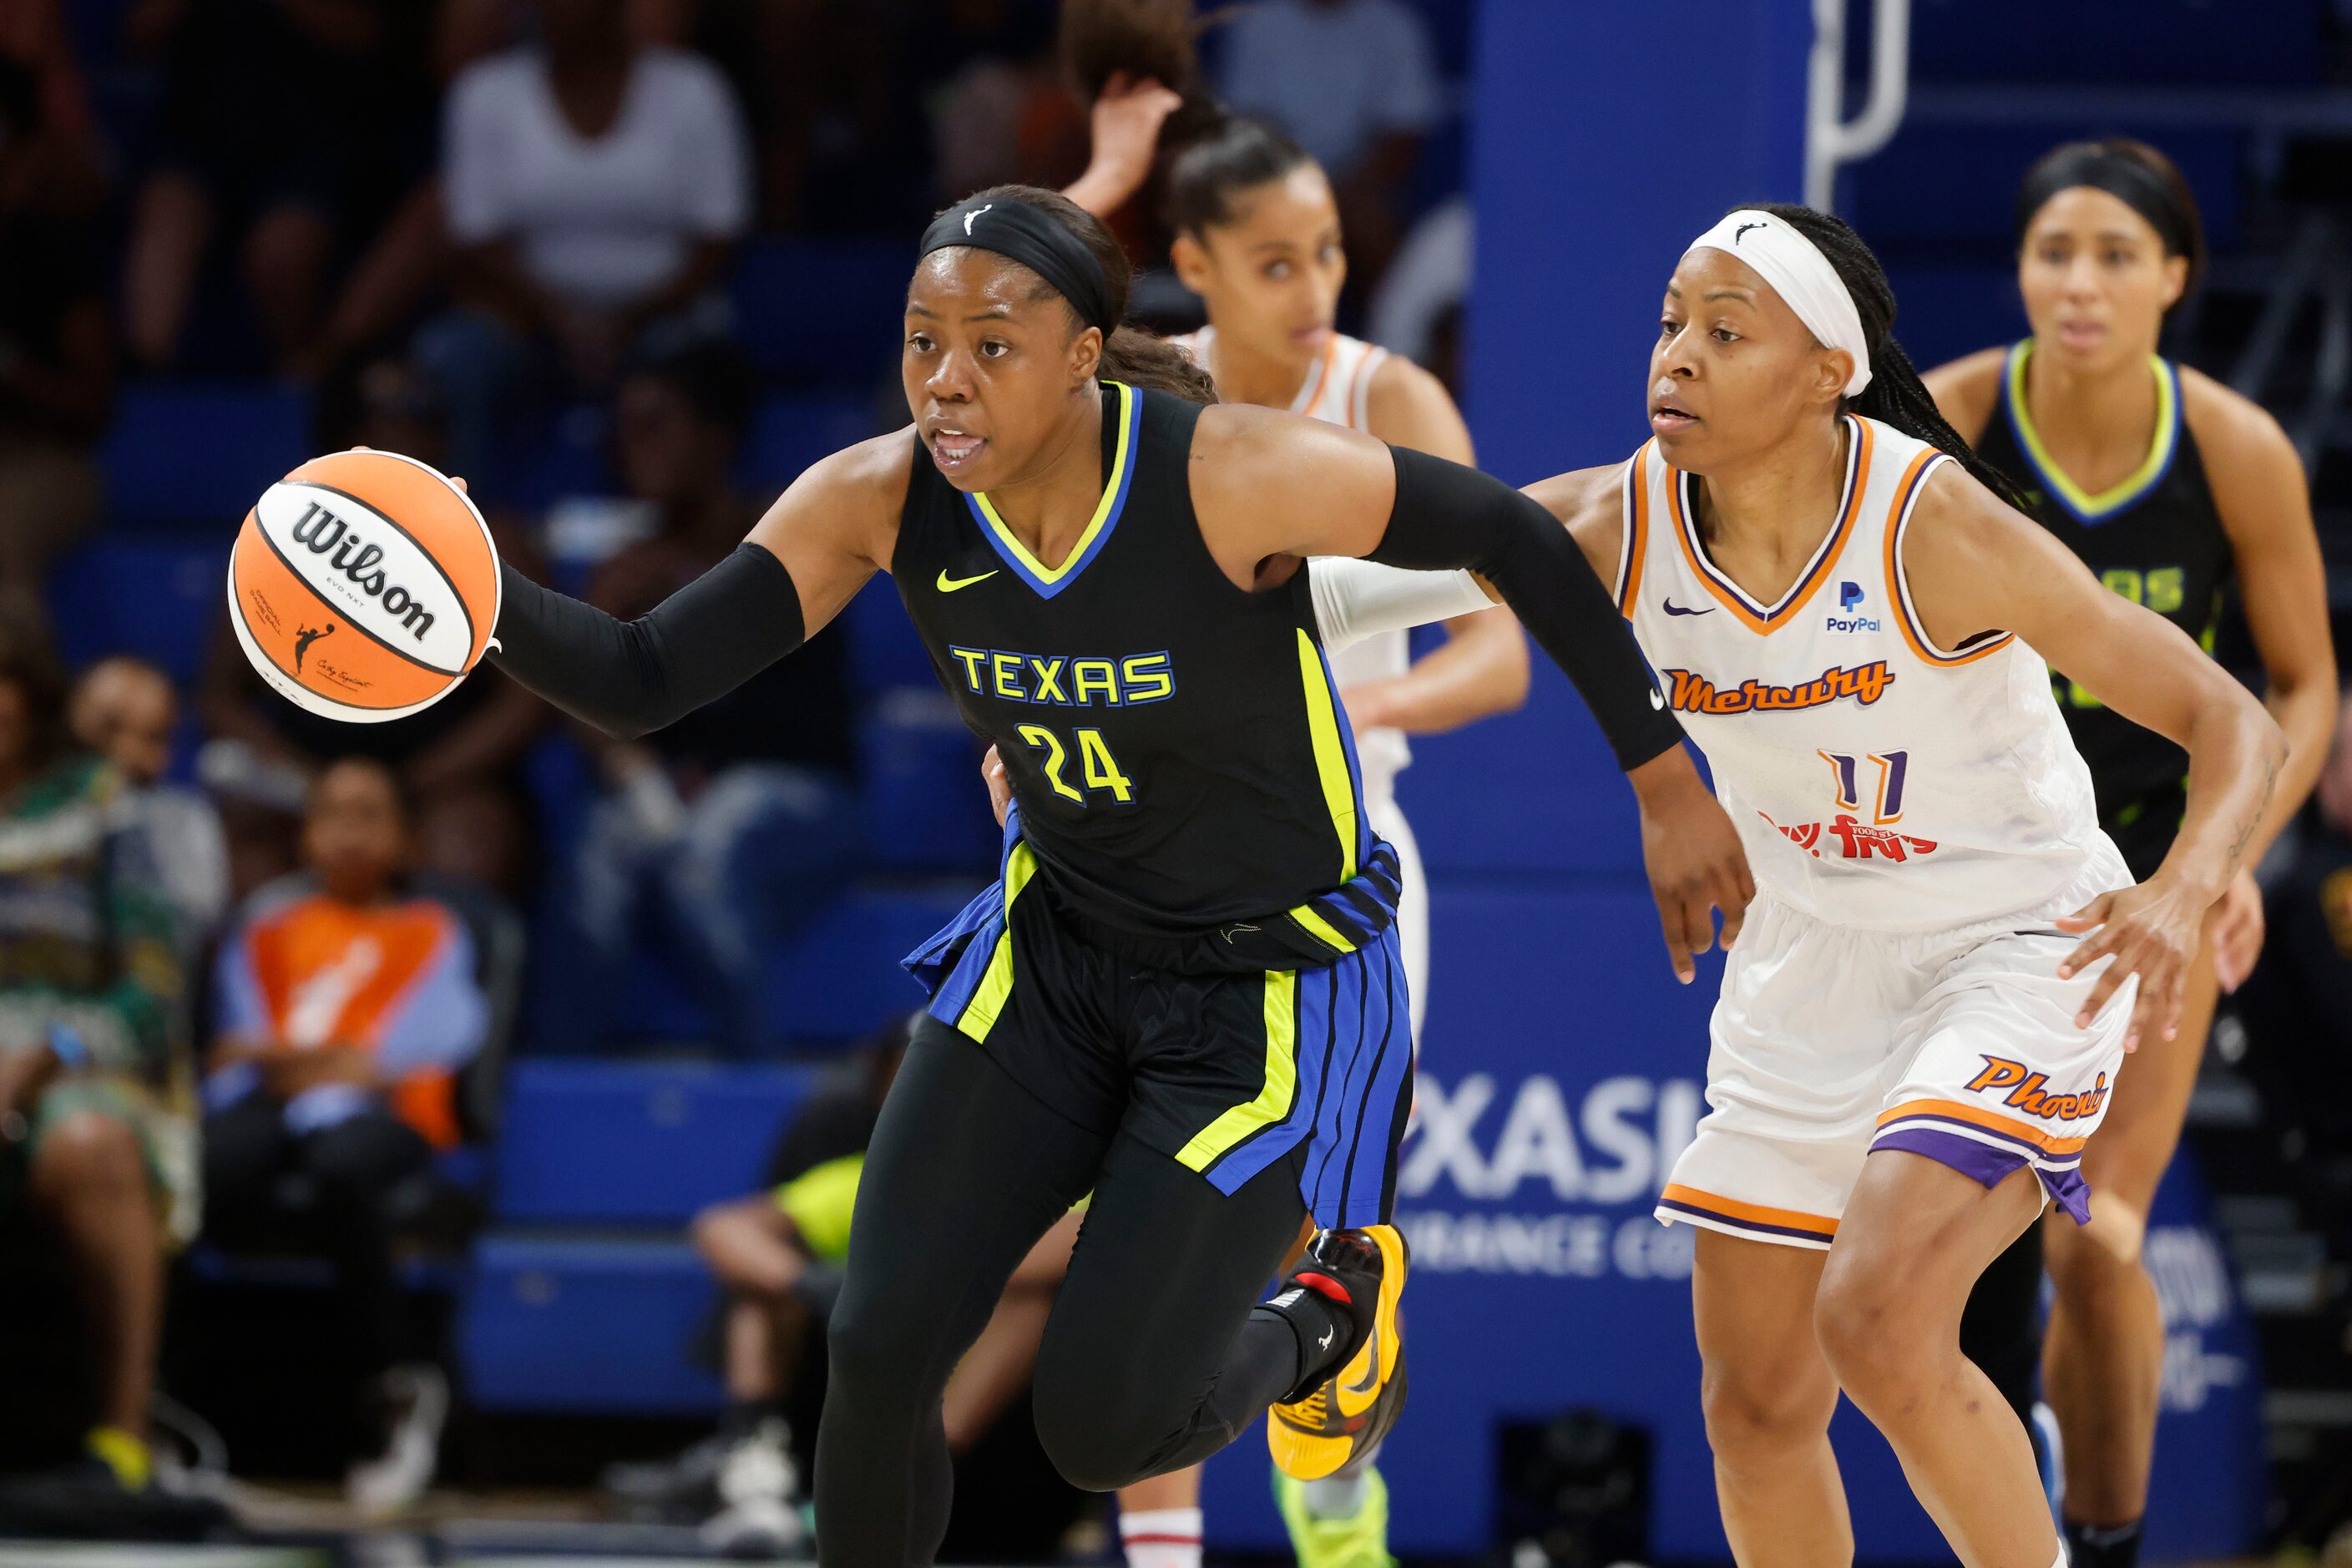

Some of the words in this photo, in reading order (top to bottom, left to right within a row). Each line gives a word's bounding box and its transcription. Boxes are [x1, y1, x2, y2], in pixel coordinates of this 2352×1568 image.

[291, 498, 437, 645] Wilson
[1827, 617, 1880, 634] PayPal
[948, 645, 1176, 707] TEXAS
[1662, 660, 1895, 714] Mercury
[1014, 721, 1136, 807] 24
[1817, 748, 1909, 825] 11
[1852, 827, 1878, 837] FOOD
